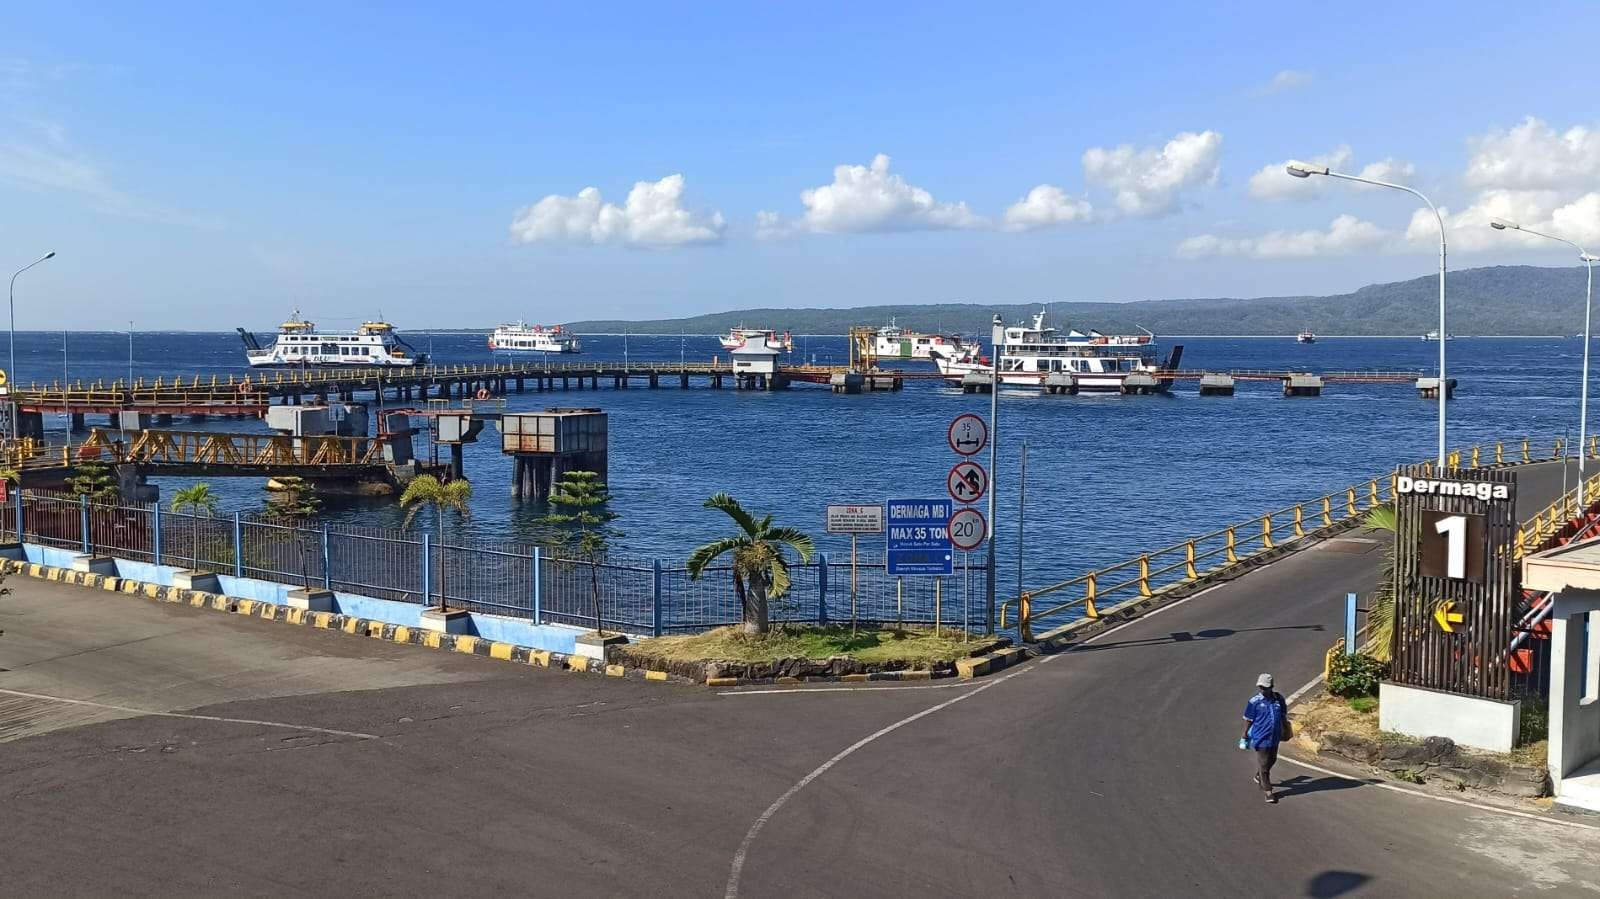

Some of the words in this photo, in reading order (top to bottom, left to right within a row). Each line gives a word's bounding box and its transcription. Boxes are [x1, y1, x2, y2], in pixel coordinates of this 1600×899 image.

[1397, 476, 1509, 500] Dermaga
[891, 504, 930, 518] DERMAGA
[932, 504, 944, 518] MB
[891, 528, 913, 539] MAX
[914, 528, 926, 540] 35
[929, 528, 948, 539] TON
[954, 522, 974, 537] 20
[1434, 516, 1466, 579] 1
